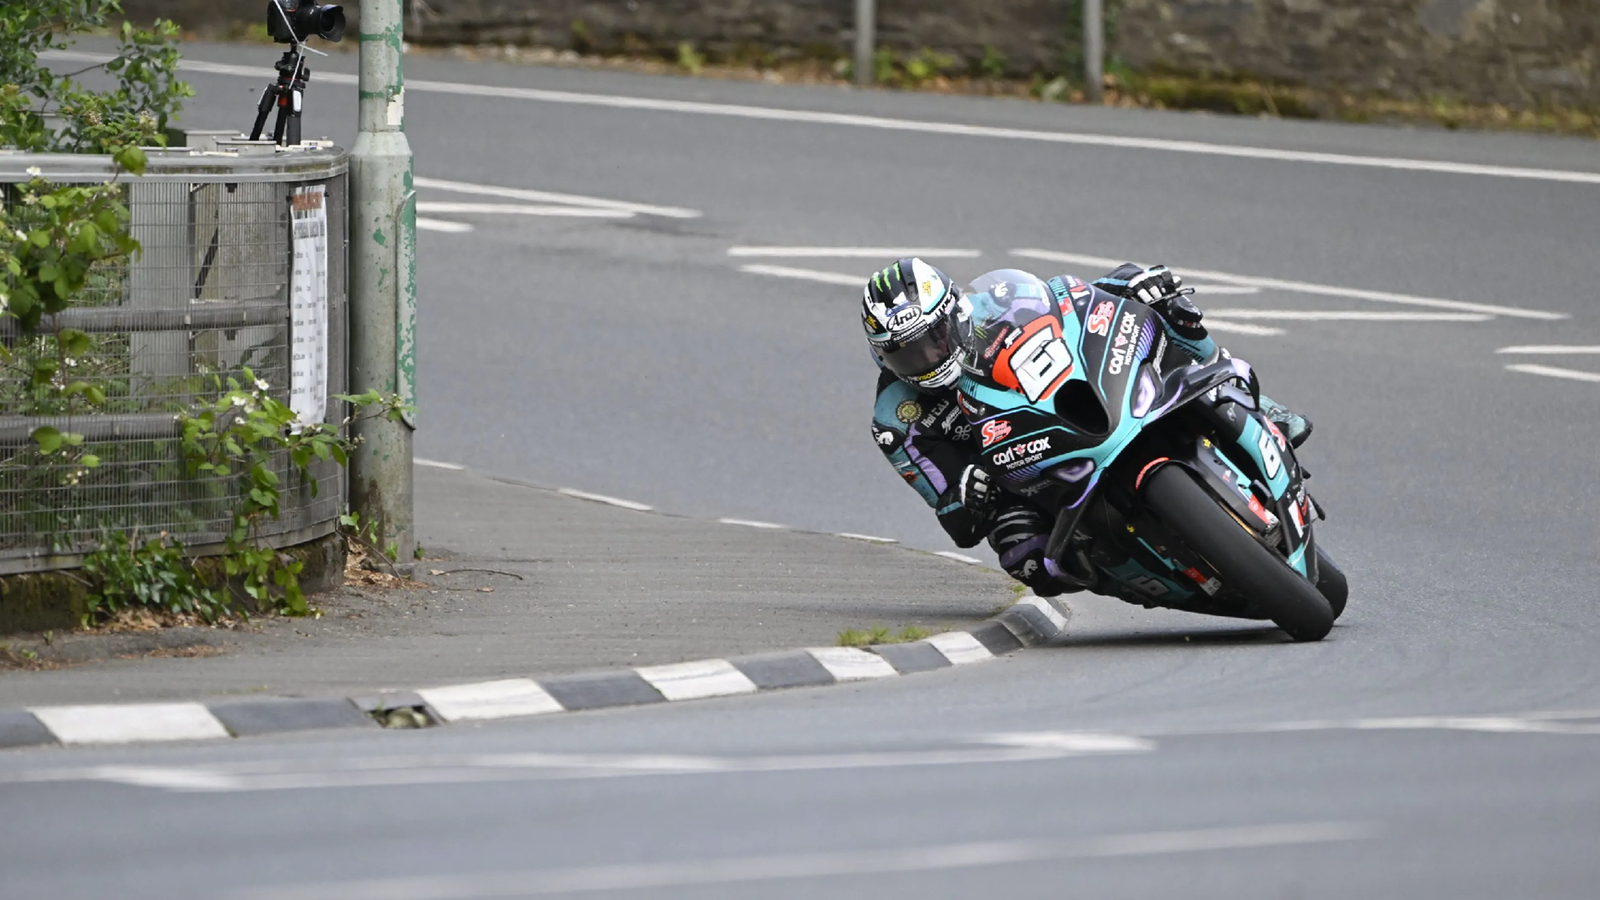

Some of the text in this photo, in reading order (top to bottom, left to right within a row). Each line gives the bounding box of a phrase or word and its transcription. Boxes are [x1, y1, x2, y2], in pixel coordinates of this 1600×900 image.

[888, 307, 919, 330] Arai
[1120, 311, 1137, 334] cox
[1123, 324, 1141, 366] MOTOR SPORT
[1008, 323, 1074, 404] 6
[992, 436, 1052, 466] carl cox
[1006, 453, 1043, 470] MOTOR SPORT
[1258, 428, 1282, 480] 6
